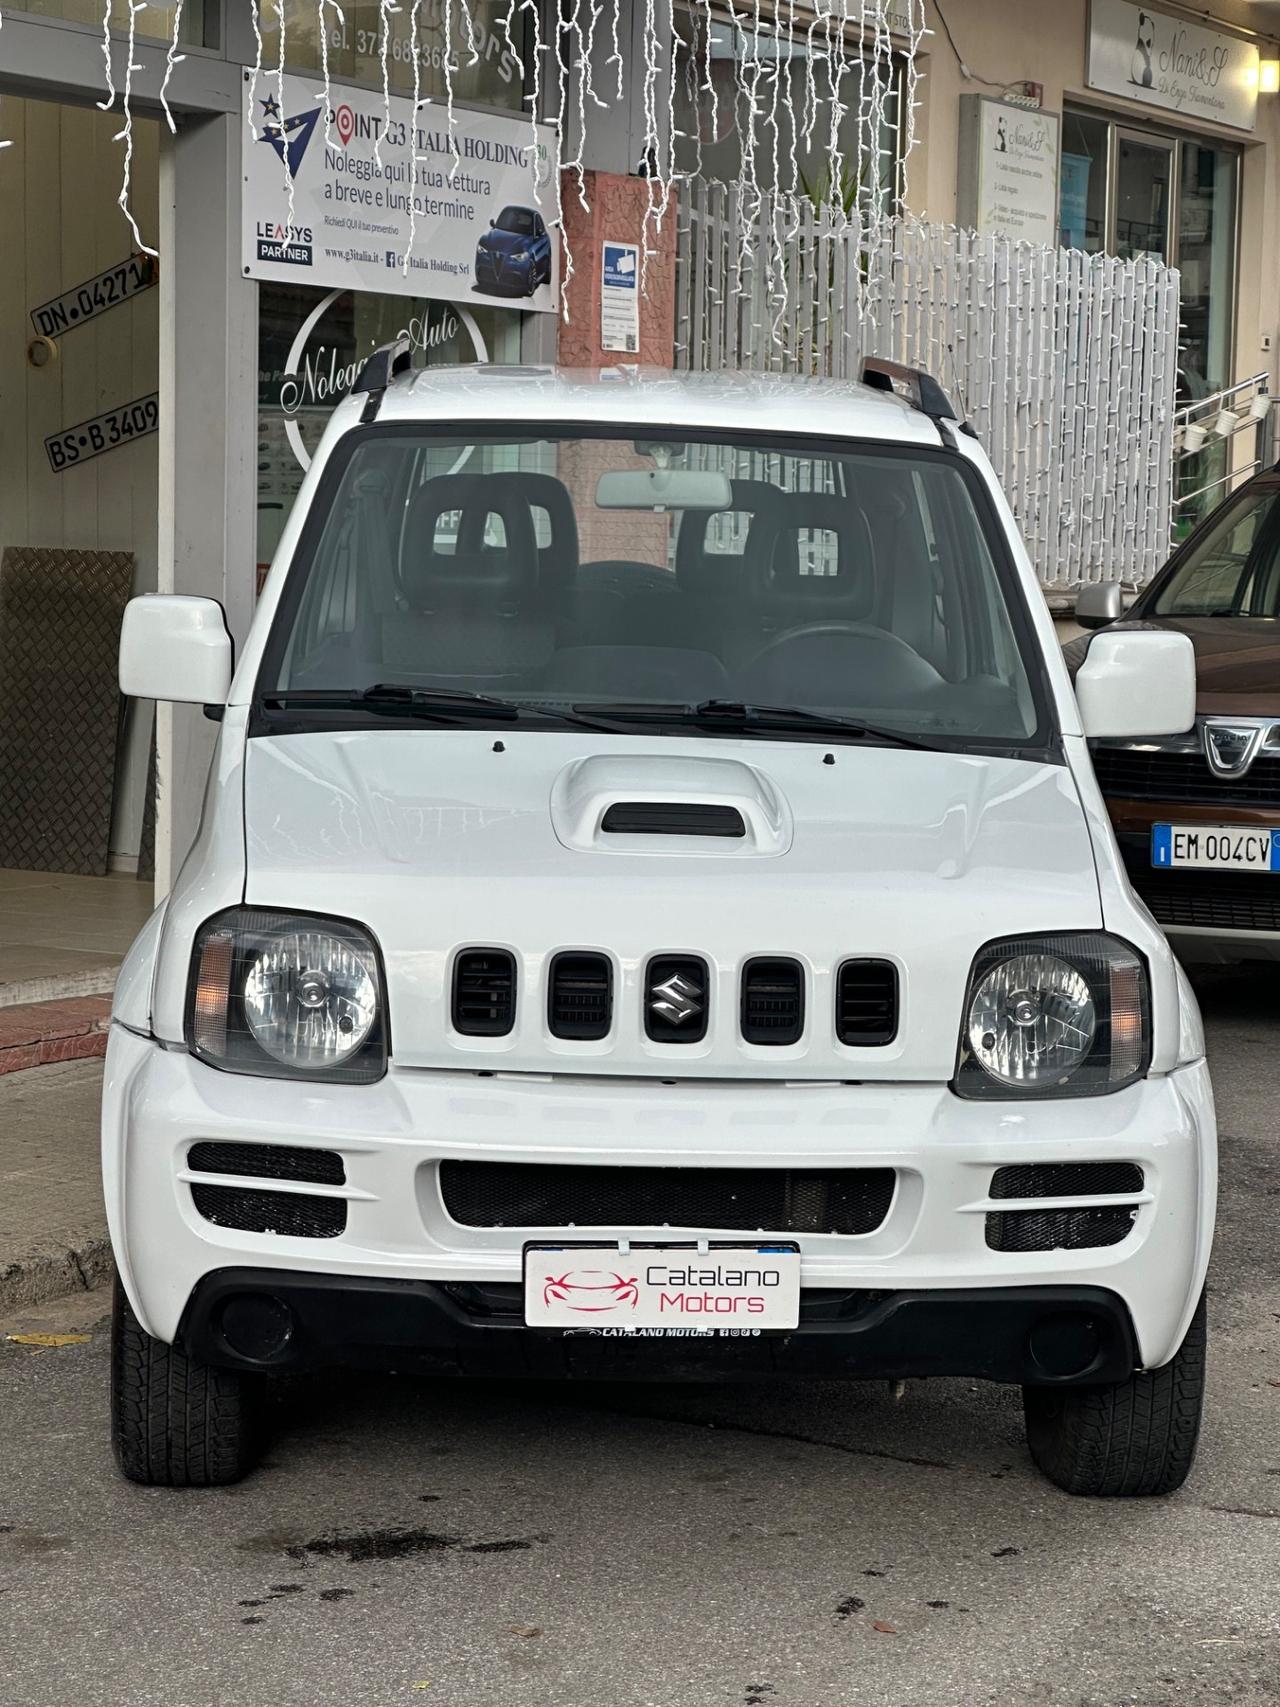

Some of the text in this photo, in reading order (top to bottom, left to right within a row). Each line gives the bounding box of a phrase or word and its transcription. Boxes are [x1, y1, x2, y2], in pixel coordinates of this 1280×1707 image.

[326, 105, 382, 145] POINT
[464, 137, 528, 169] HOLDING
[324, 148, 382, 181] Noleggia
[385, 161, 406, 186] qui
[421, 166, 443, 184] tua
[445, 170, 491, 196] vettura
[324, 178, 475, 221] a breve e lungo termine
[256, 221, 313, 243] LEASYS
[260, 243, 309, 262] PARTNER
[324, 248, 379, 264] www.g3italia.it
[410, 257, 429, 270] Italia
[430, 259, 458, 275] Holding
[458, 263, 470, 276] Srl
[407, 306, 460, 356] Auto
[1173, 833, 1199, 860] EM
[1205, 835, 1270, 864] 004CV
[646, 1265, 780, 1287] Catalano
[660, 1291, 765, 1313] Motors
